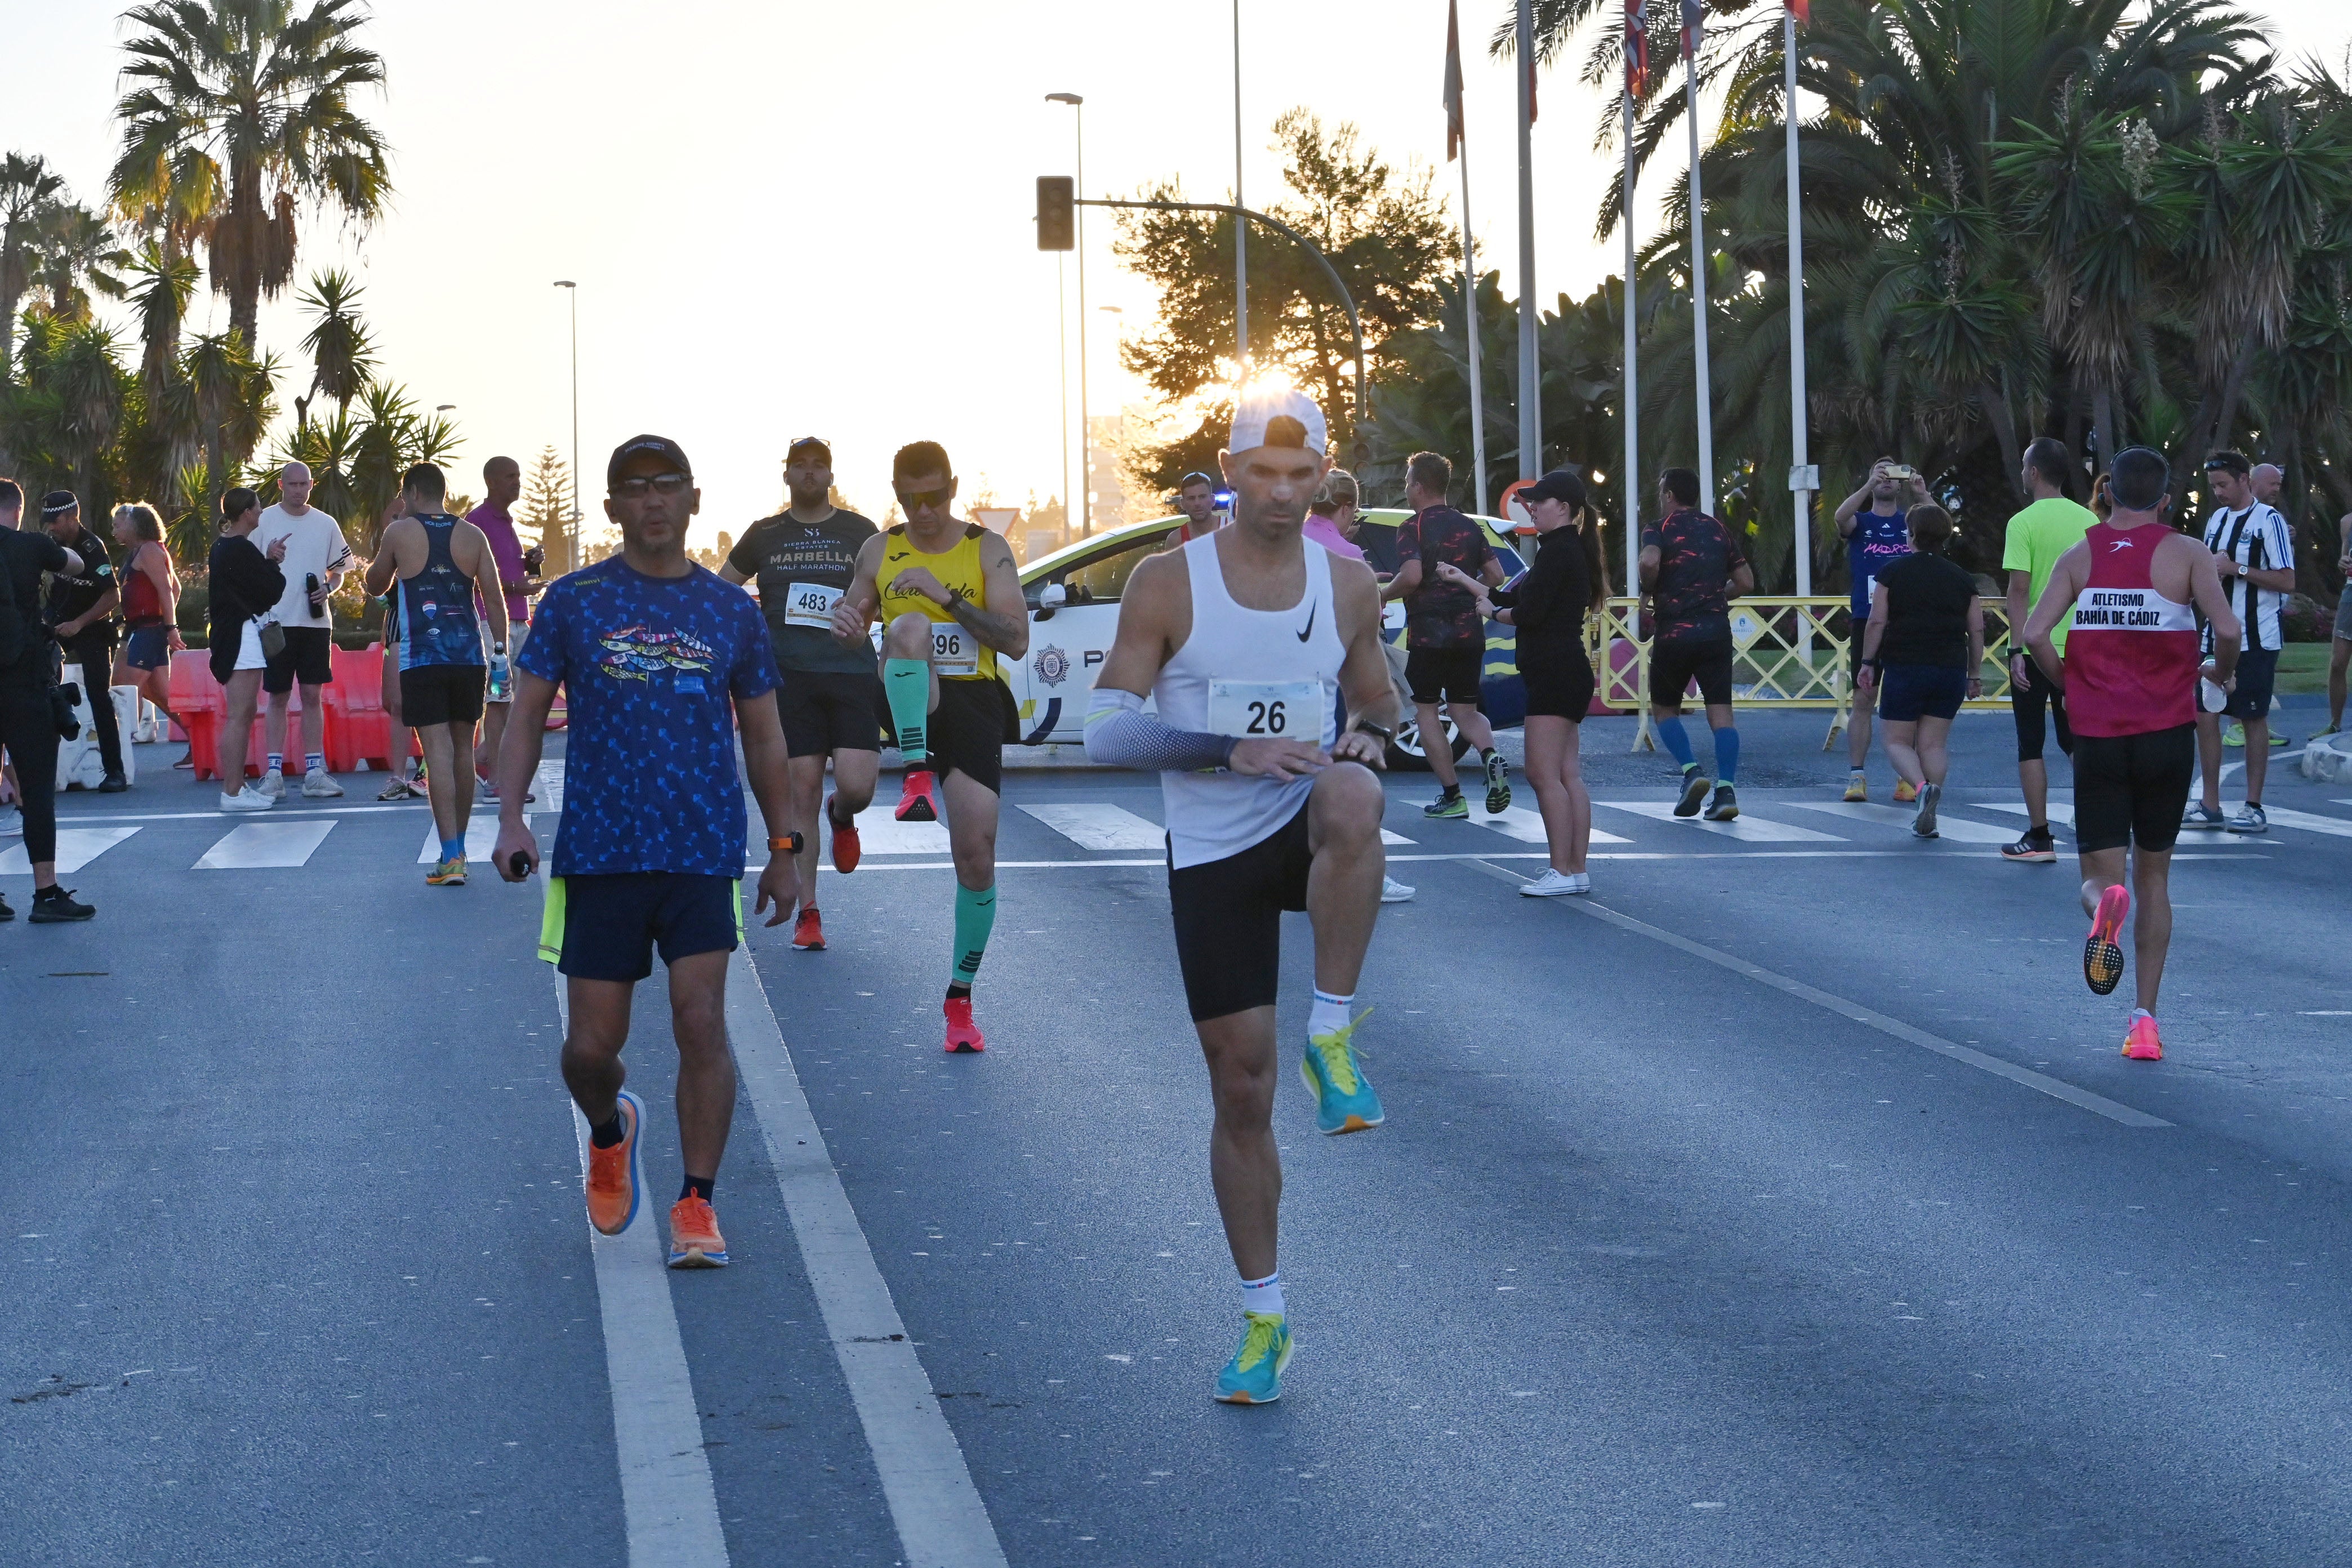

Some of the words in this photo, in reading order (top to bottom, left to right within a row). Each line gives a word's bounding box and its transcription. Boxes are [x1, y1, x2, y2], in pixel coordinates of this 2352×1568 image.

[770, 551, 854, 564] MARBELLA
[799, 593, 826, 612] 483
[2092, 593, 2144, 607] ATLETISMO
[2076, 607, 2109, 625] BAHÍA
[2112, 611, 2124, 625] DE
[2128, 608, 2160, 626] CÁDIZ
[1246, 701, 1285, 734] 26
